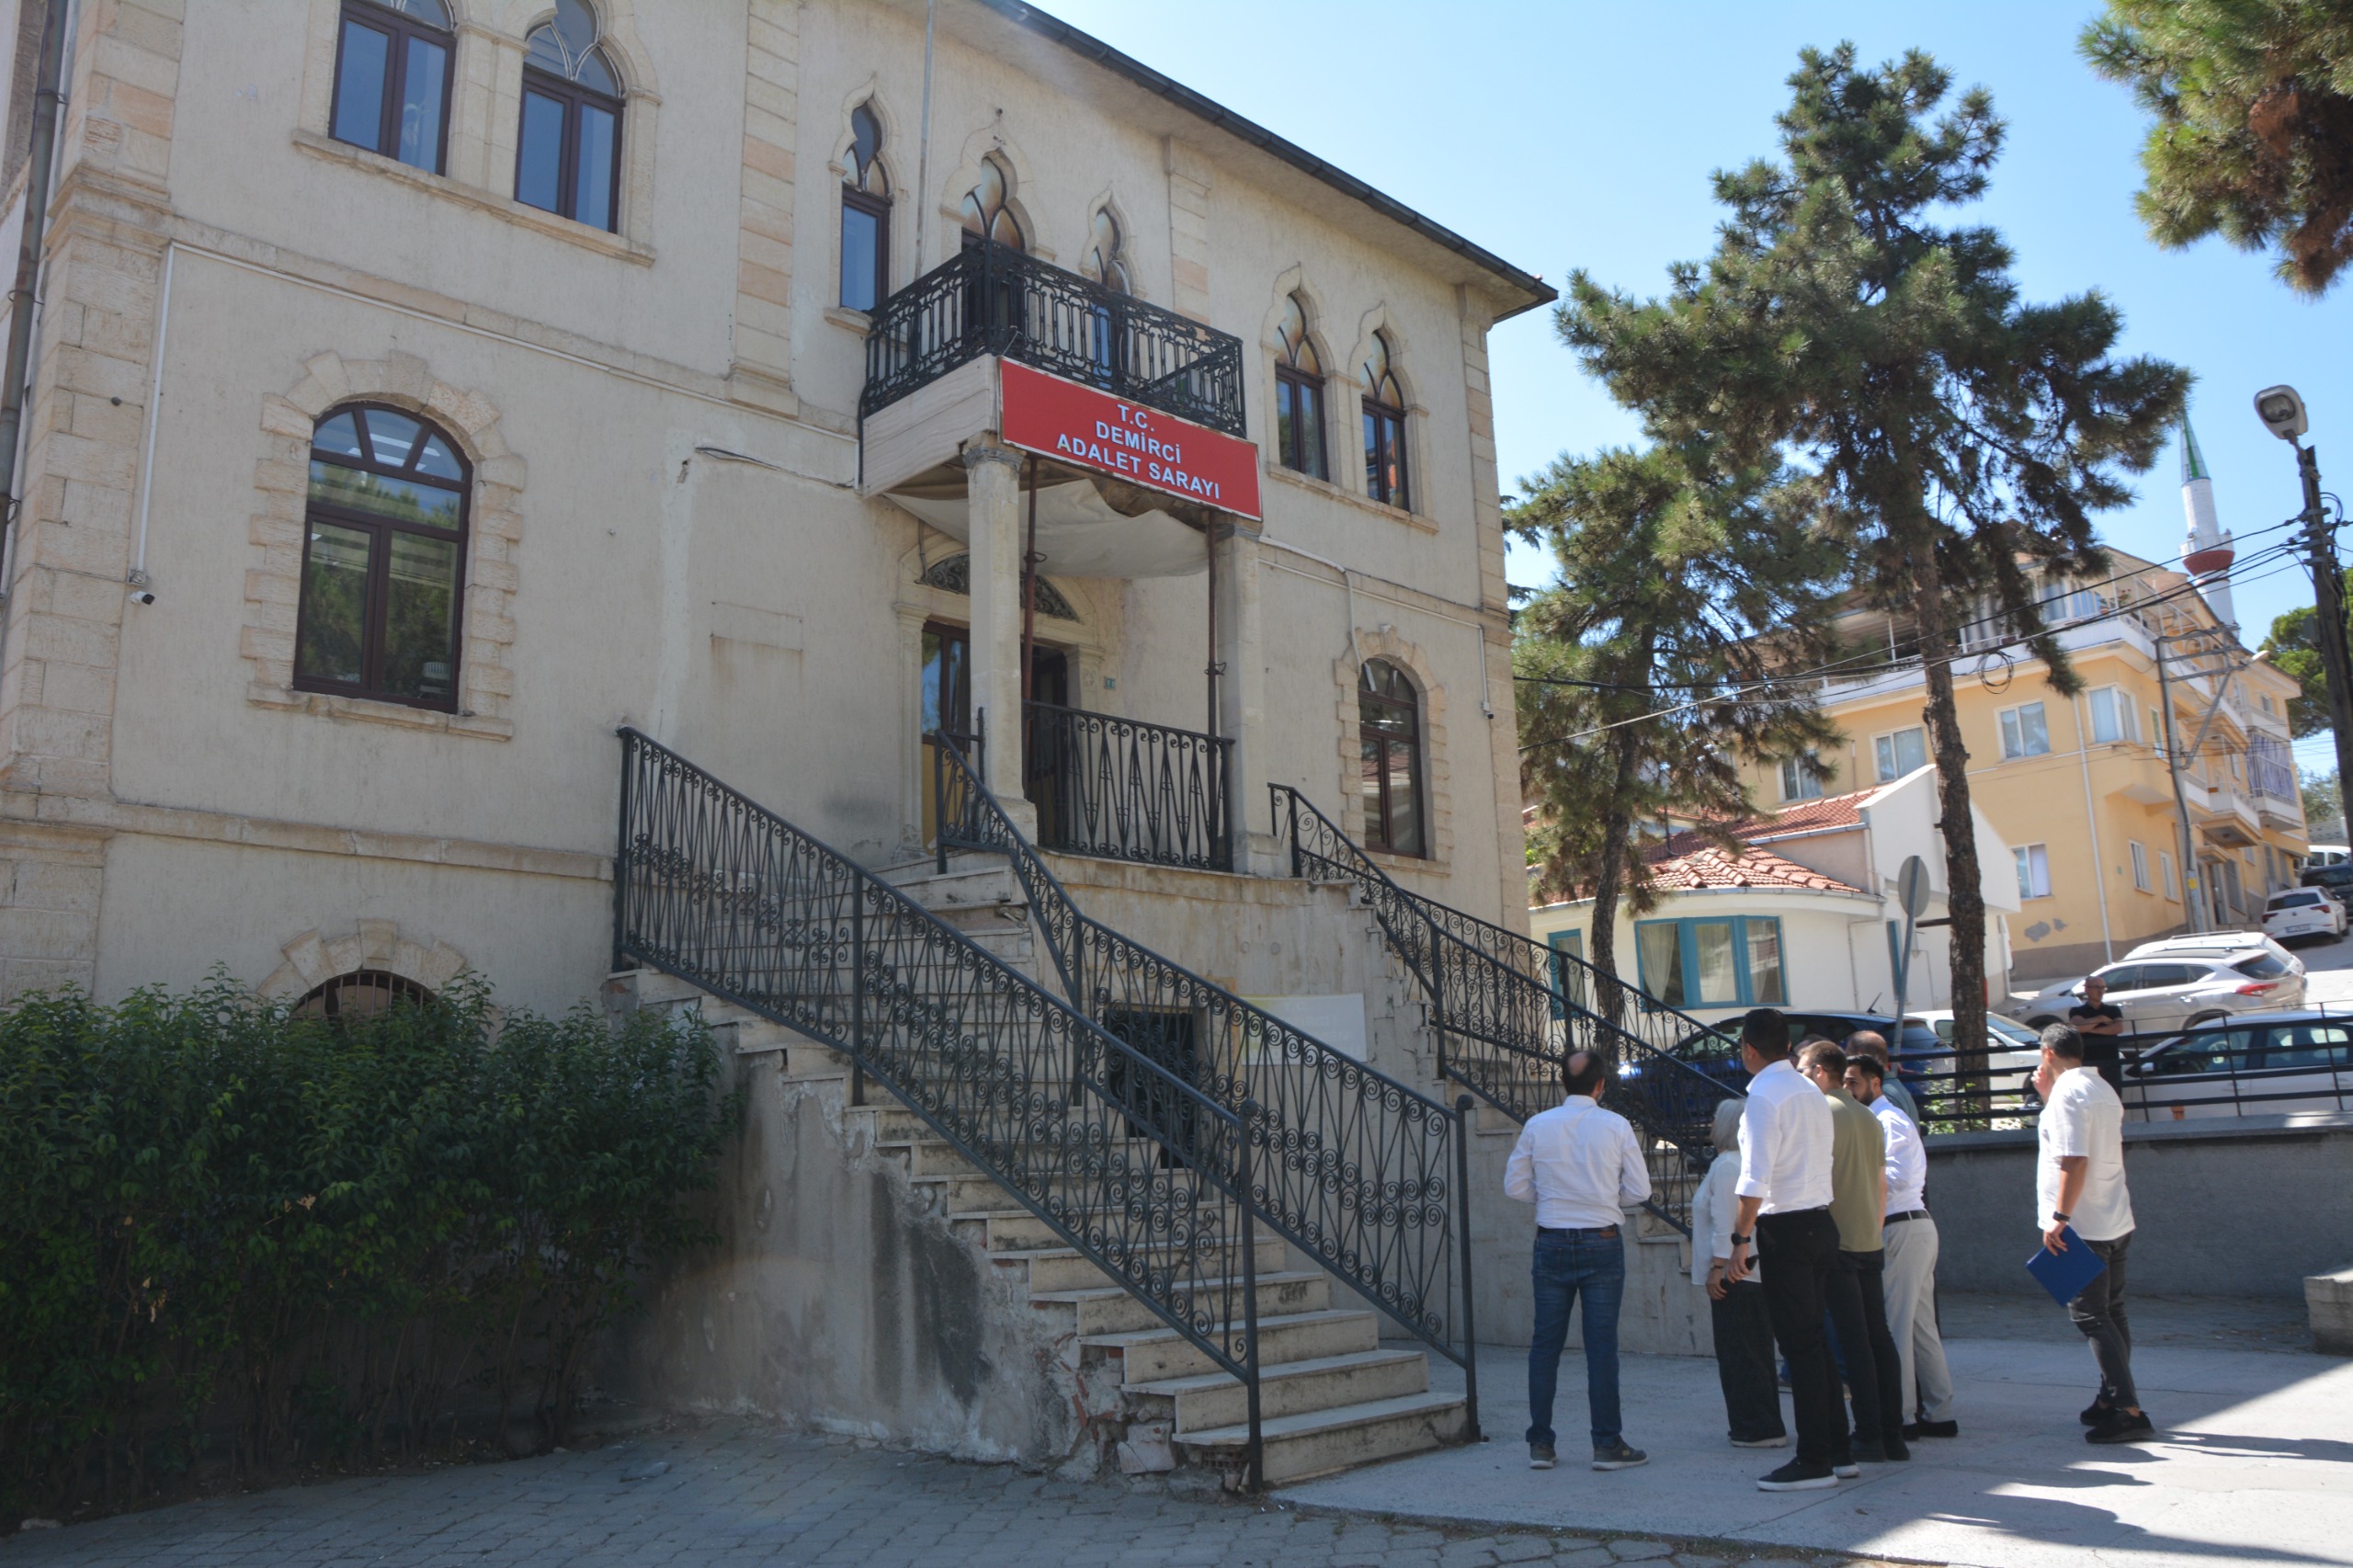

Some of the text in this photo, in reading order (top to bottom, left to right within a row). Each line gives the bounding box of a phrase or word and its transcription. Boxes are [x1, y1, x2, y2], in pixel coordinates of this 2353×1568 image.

[1117, 403, 1154, 432] T.C.
[1096, 420, 1181, 464] DEMİRCİ
[1056, 434, 1220, 499] ADALET SARAYI
